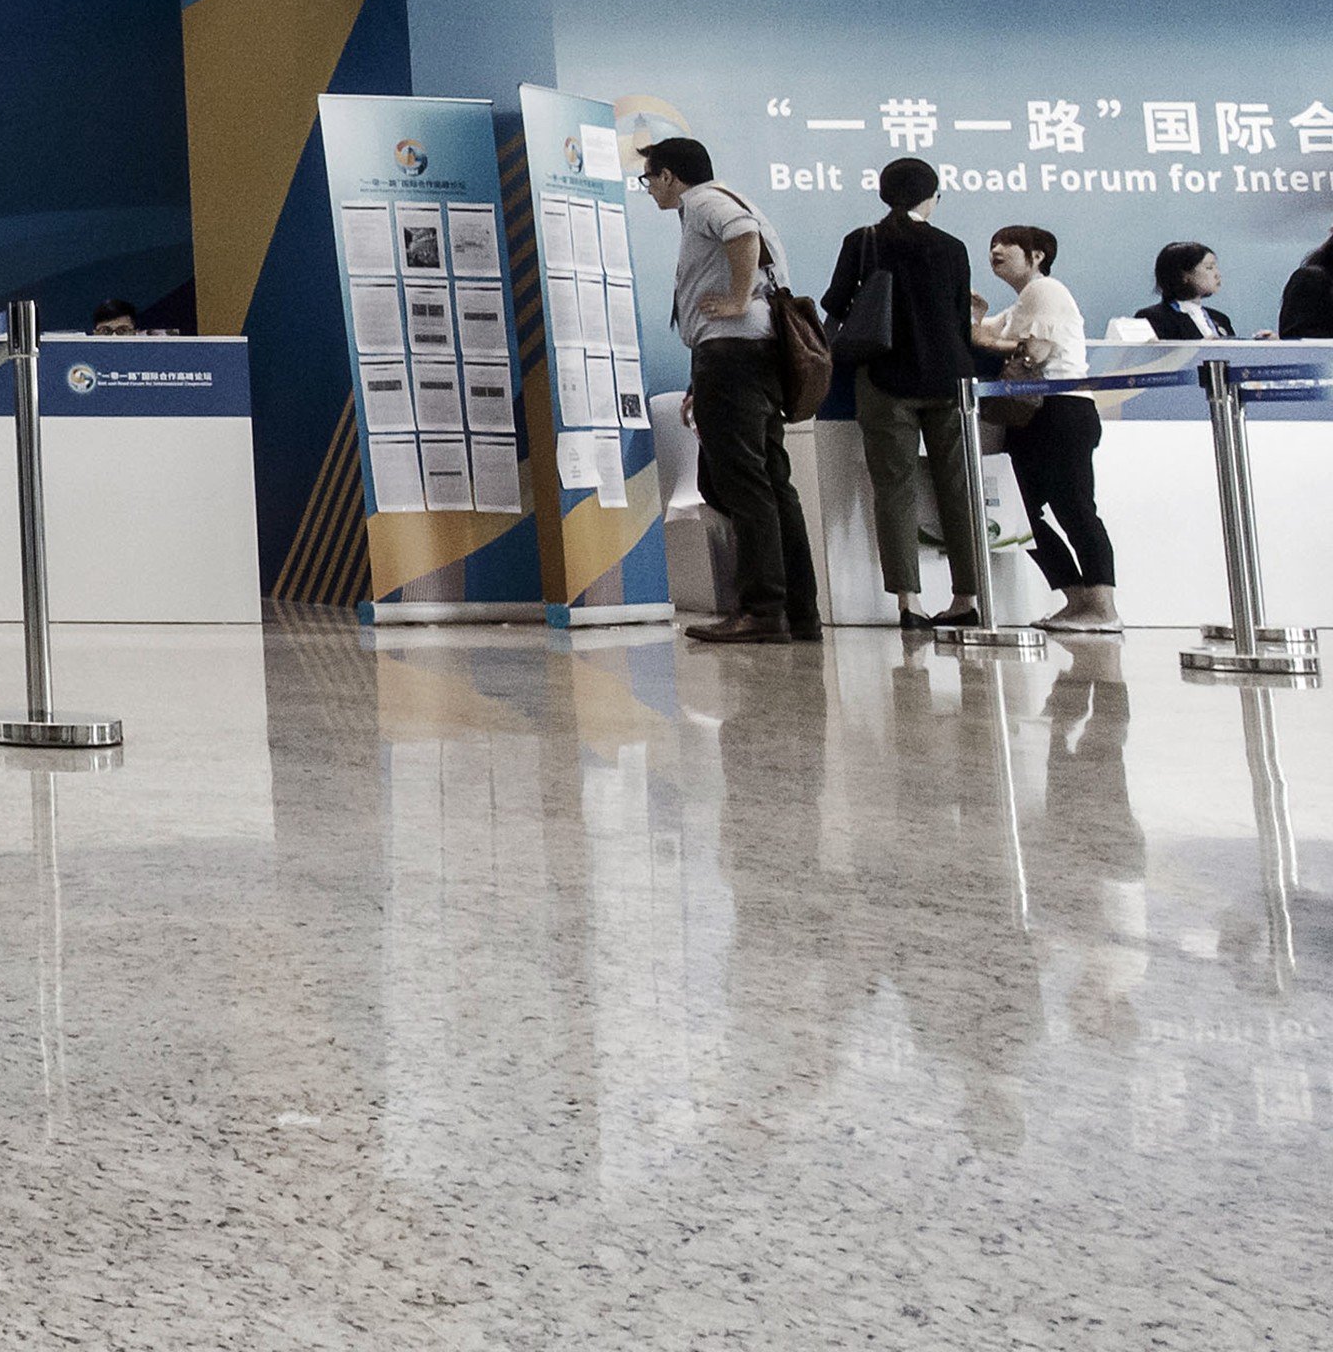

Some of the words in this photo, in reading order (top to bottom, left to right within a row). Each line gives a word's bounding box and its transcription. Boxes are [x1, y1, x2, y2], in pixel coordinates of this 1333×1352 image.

[770, 162, 843, 191] Belt
[938, 162, 1027, 192] Road
[1040, 163, 1157, 193] Forum
[1169, 163, 1222, 193] for
[1233, 164, 1333, 193] Inter
